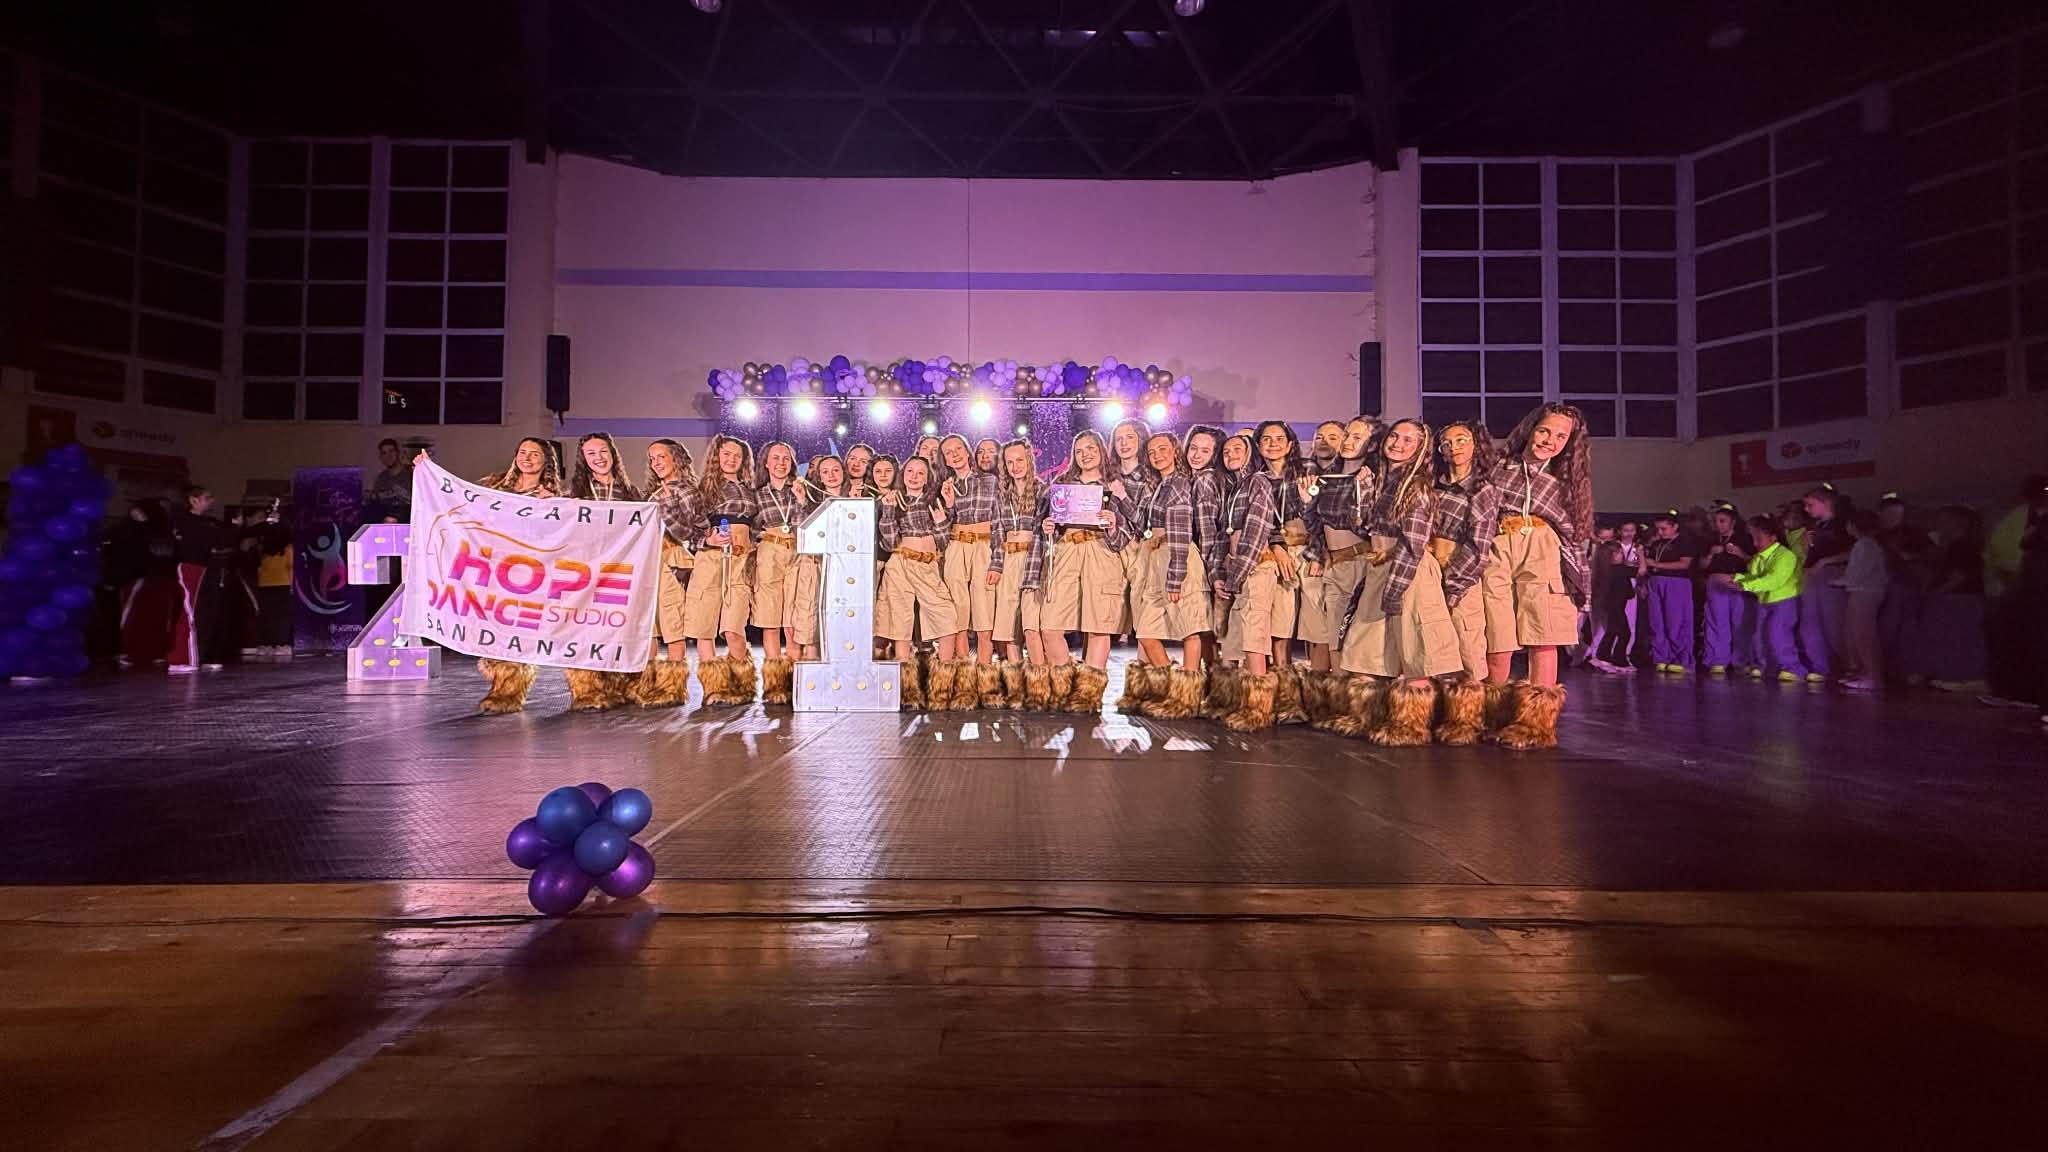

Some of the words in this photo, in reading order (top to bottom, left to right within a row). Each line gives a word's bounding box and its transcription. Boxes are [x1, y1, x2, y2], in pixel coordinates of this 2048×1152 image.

[440, 477, 644, 527] BULGARIA
[448, 538, 634, 606] HOPE
[546, 605, 627, 629] STUDIO
[793, 497, 900, 712] 1
[427, 612, 623, 661] SANDANSKI
